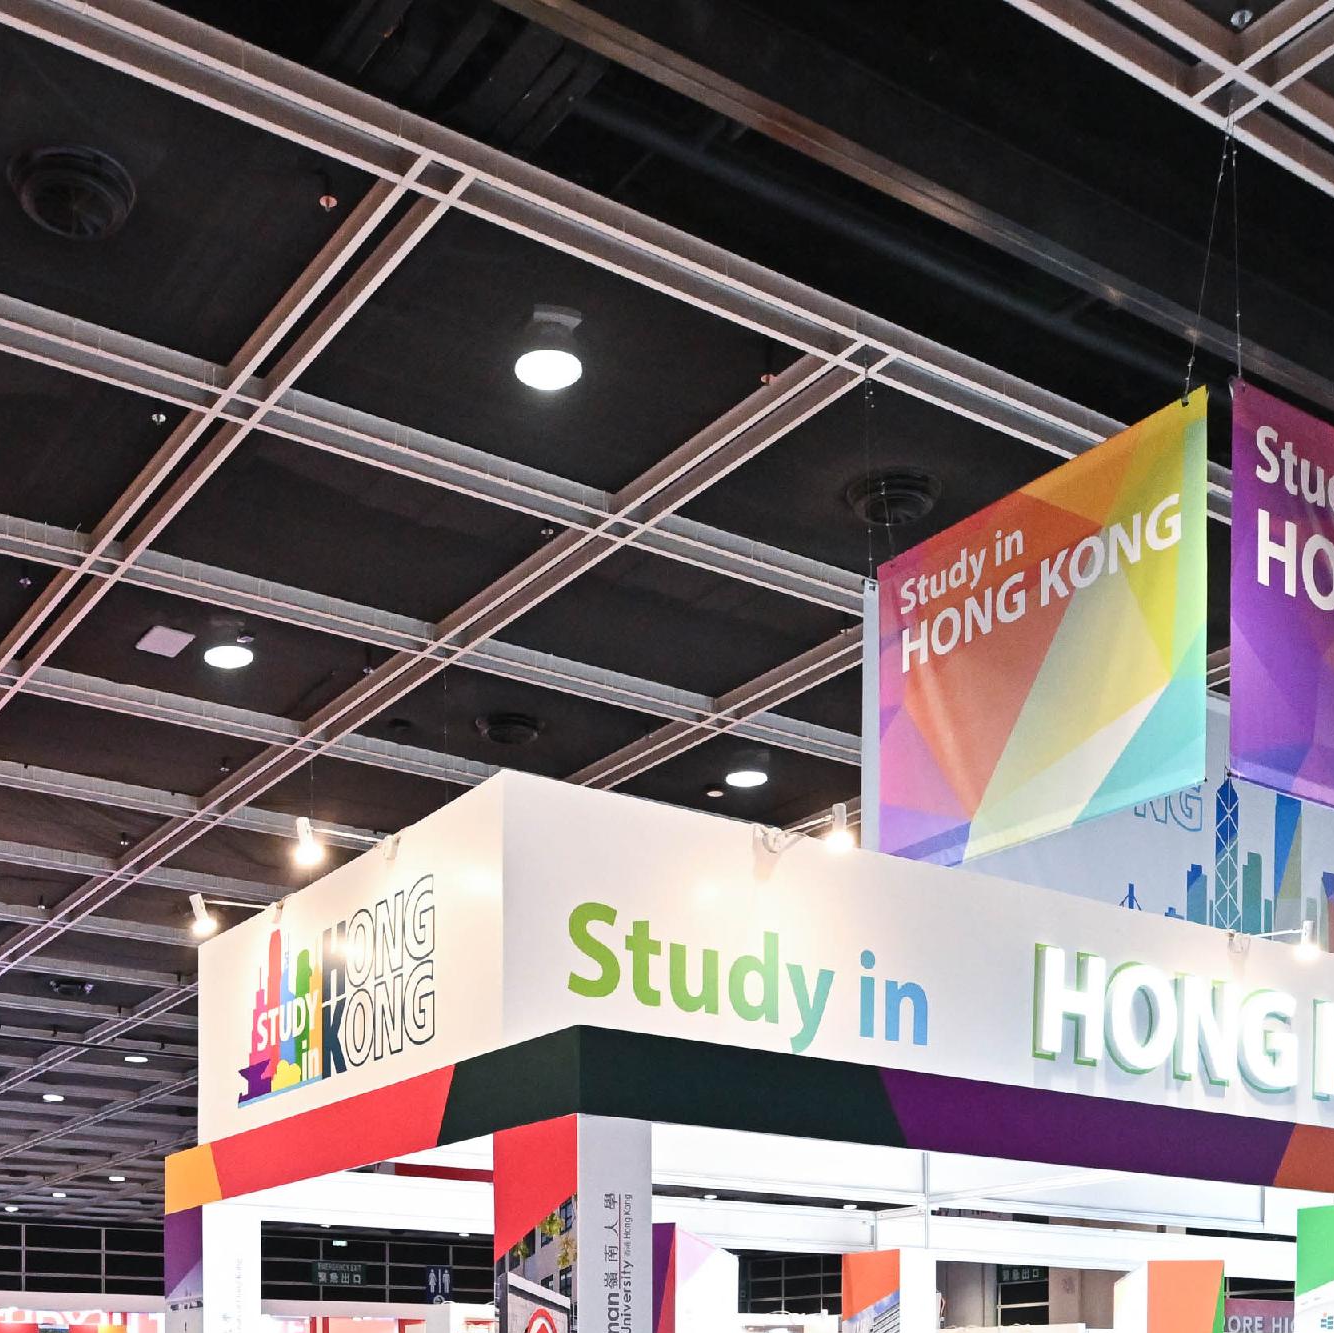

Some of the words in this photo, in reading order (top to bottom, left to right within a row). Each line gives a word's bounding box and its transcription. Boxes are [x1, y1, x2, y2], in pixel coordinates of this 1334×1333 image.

[900, 545, 986, 615] Study
[995, 527, 1024, 566] in
[902, 572, 1027, 673] HONG
[1040, 494, 1182, 607] KONG
[323, 874, 435, 996] HONG
[257, 991, 318, 1051] STUDY
[322, 959, 435, 1079] KONG
[567, 901, 834, 1054] Study
[859, 949, 930, 1046] in
[1032, 942, 1298, 1095] HONG
[301, 1041, 320, 1082] in
